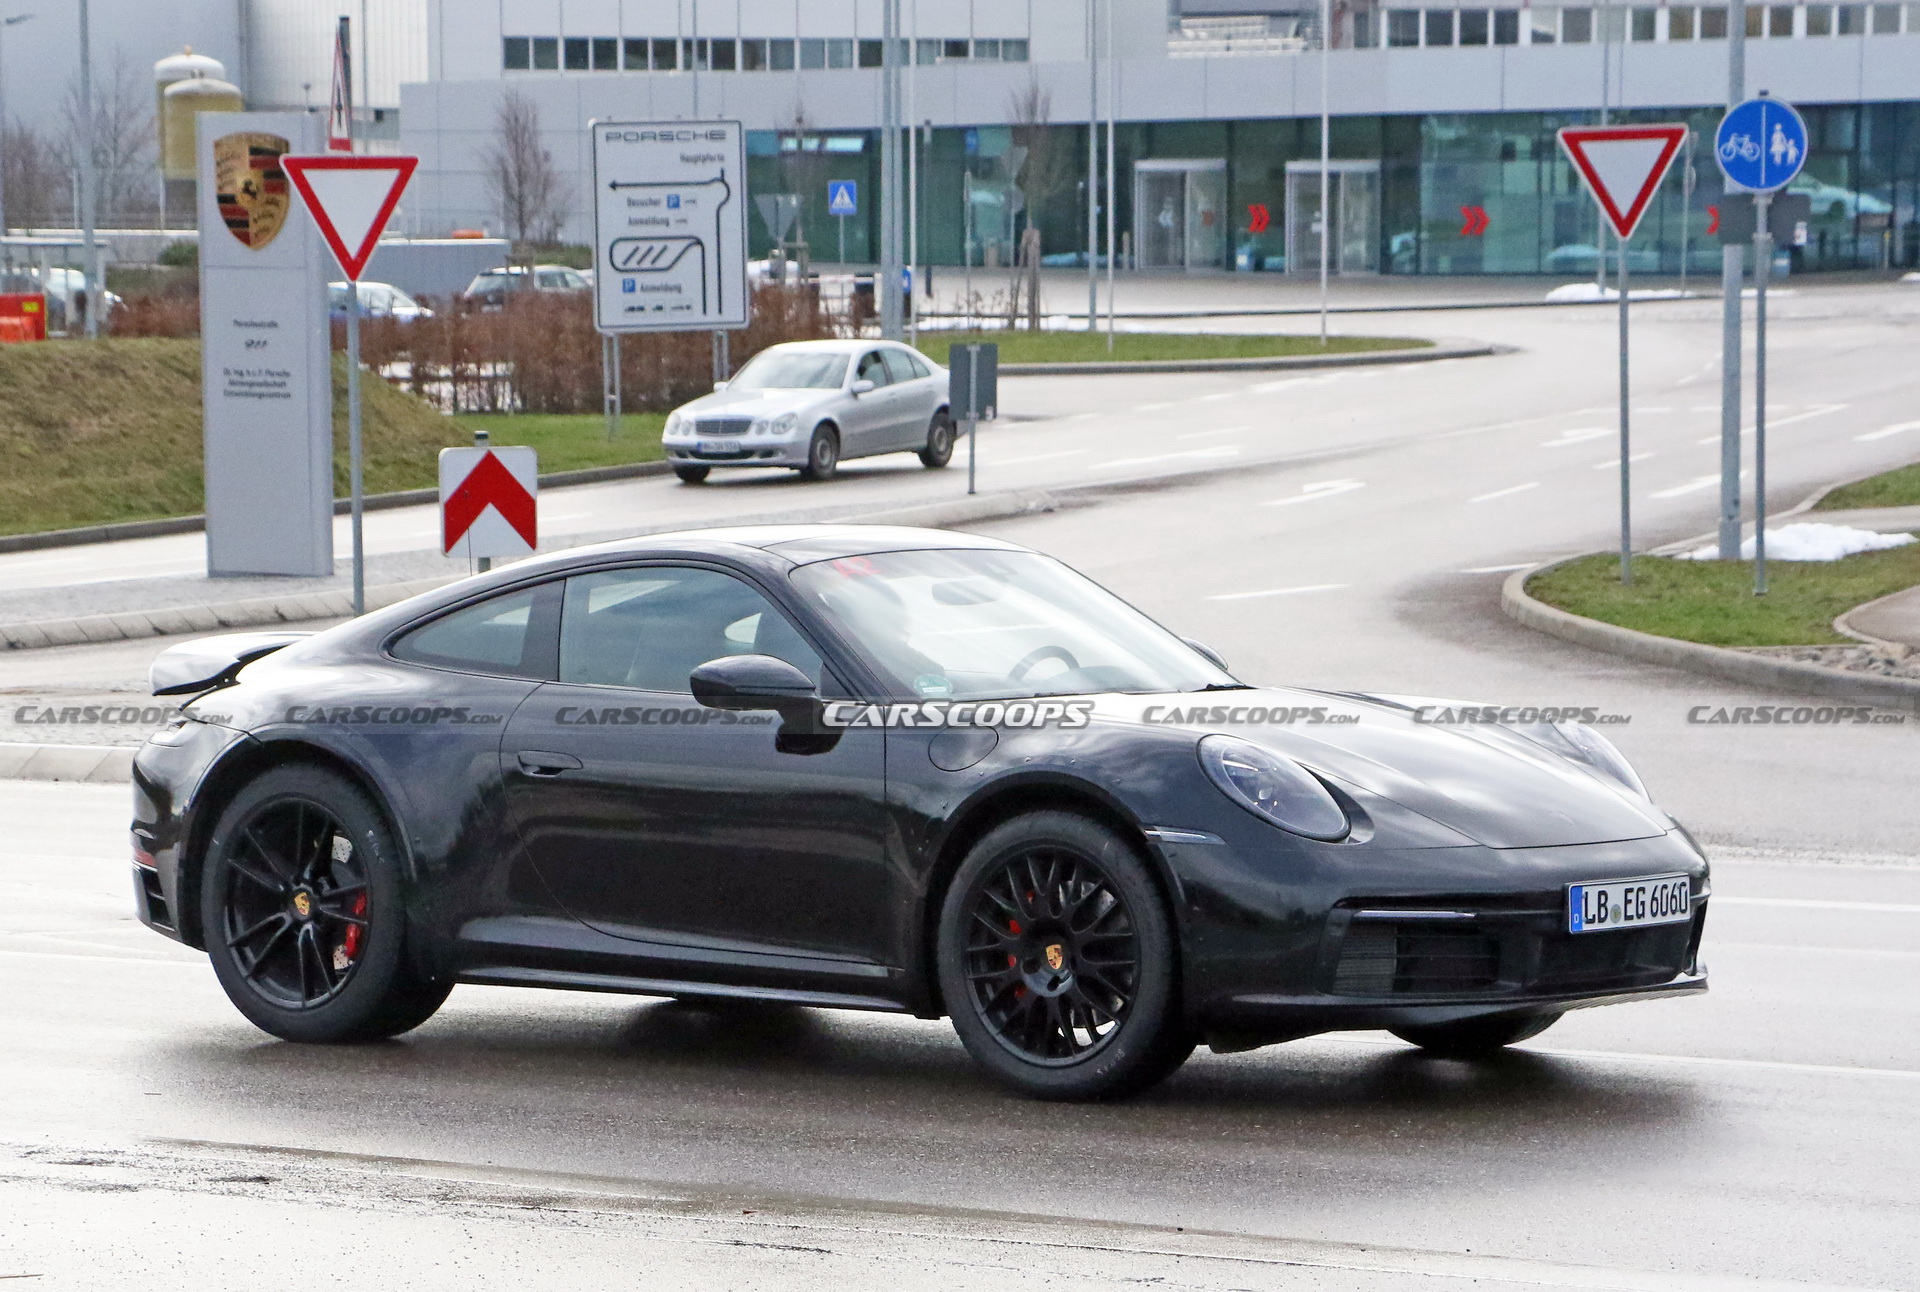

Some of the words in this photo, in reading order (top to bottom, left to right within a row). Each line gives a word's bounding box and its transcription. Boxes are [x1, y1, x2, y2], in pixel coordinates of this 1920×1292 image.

[606, 129, 726, 143] PORSCHE
[628, 216, 670, 227] Anmeldung
[640, 282, 682, 294] Anmeldung
[1584, 890, 1609, 924] LB
[1624, 886, 1646, 921] EG
[1650, 881, 1688, 918] 6060
